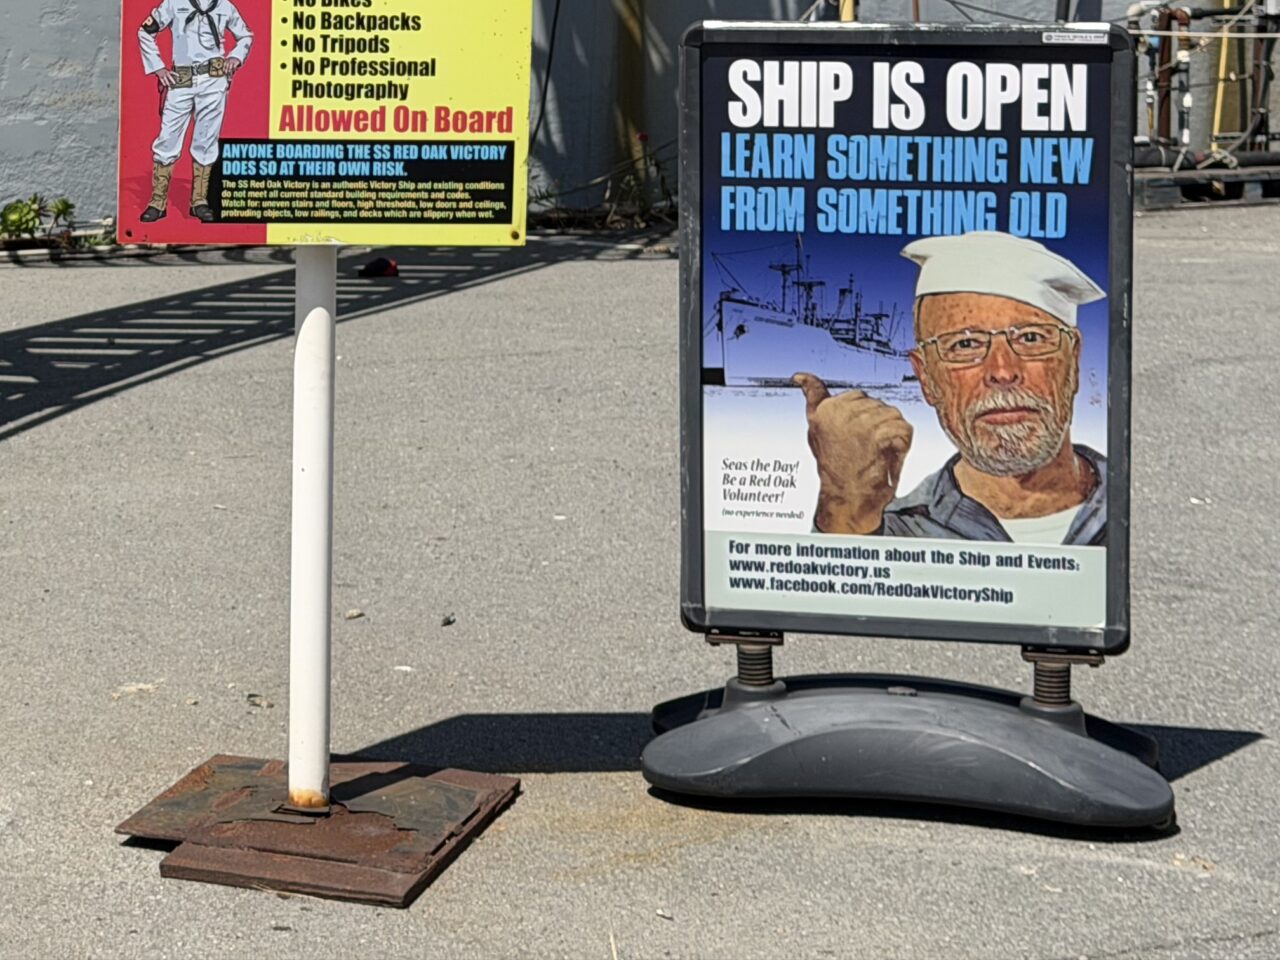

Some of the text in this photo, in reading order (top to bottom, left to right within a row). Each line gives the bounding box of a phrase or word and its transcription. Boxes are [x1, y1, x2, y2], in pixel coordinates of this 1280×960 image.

[293, 12, 422, 32] No Backpacks
[292, 34, 390, 55] No Tripods
[292, 57, 436, 77] No Professional
[291, 80, 409, 101] Photography
[727, 58, 1088, 132] SHIP IS OPEN
[279, 105, 514, 133] Allowed On Board
[222, 144, 507, 160] ANYONE BOARDING THE SS RED OAK VICTORY
[721, 132, 1094, 185] LEARN SOMETHING NEW
[222, 161, 408, 176] DOES SO AT THEIR OWN RISK.
[221, 190, 231, 198] do
[233, 190, 246, 198] not
[248, 190, 267, 198] meet
[269, 190, 278, 198] all
[346, 191, 376, 201] building
[378, 191, 428, 201] requirements
[222, 180, 236, 188] The
[238, 180, 248, 188] SS
[250, 180, 265, 188] Red
[267, 180, 281, 189] Oak
[284, 181, 310, 191] Victory
[312, 181, 319, 189] is
[332, 181, 368, 189] authentic
[370, 181, 396, 191] Victory
[398, 181, 415, 191] Ship
[417, 181, 431, 189] and
[433, 182, 463, 191] existing
[221, 200, 245, 208] Watch
[247, 200, 260, 208] for:
[292, 200, 313, 208] stairs
[315, 200, 329, 208] and
[332, 200, 355, 210] floors,
[357, 201, 374, 210] high
[376, 201, 418, 210] thresholds,
[474, 201, 506, 211] ceilings,
[221, 210, 261, 219] protruding
[263, 210, 293, 219] objects,
[295, 210, 308, 218] low
[311, 210, 341, 220] railings,
[343, 210, 357, 218] and
[360, 210, 382, 218] decks
[384, 210, 407, 218] which
[423, 210, 453, 220] slippery
[720, 185, 1068, 239] FROM SOMETHING OLD
[722, 458, 800, 476] Seas the Day!
[722, 473, 797, 488] Be a Red Oak
[722, 488, 785, 504] Volunteer!
[722, 508, 805, 519] (no experience needed)
[729, 539, 1080, 571] For more information about the Ship and Events:
[729, 559, 891, 579] www.redoakvictory.us
[729, 576, 1014, 604] www.facebook.com/RedOakVictoryShip
